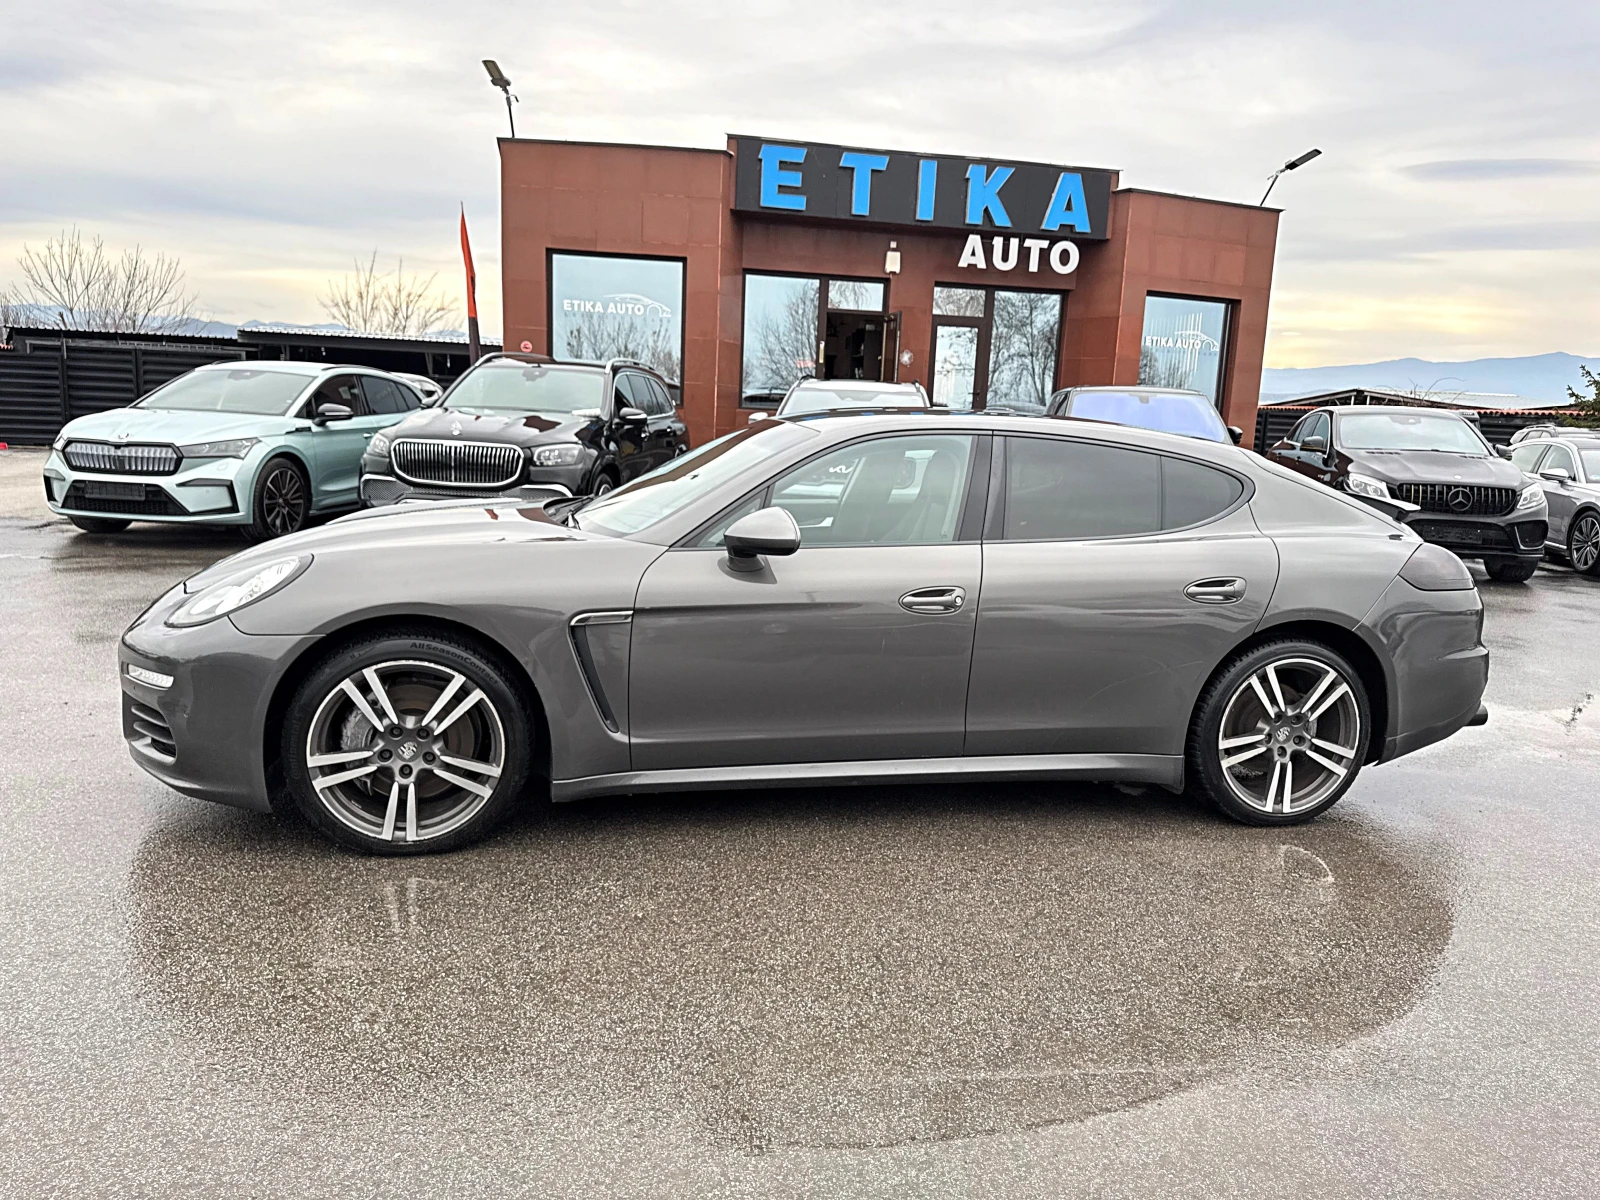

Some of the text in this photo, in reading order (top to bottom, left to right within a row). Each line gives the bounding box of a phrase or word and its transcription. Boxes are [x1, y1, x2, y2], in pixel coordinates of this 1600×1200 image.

[758, 143, 1092, 233] ETIKA
[957, 234, 1080, 275] AUTO
[563, 299, 645, 316] ETIKA AUTO
[1144, 335, 1201, 349] ETIKA AUTO
[409, 642, 499, 685] AllSeasonContact
